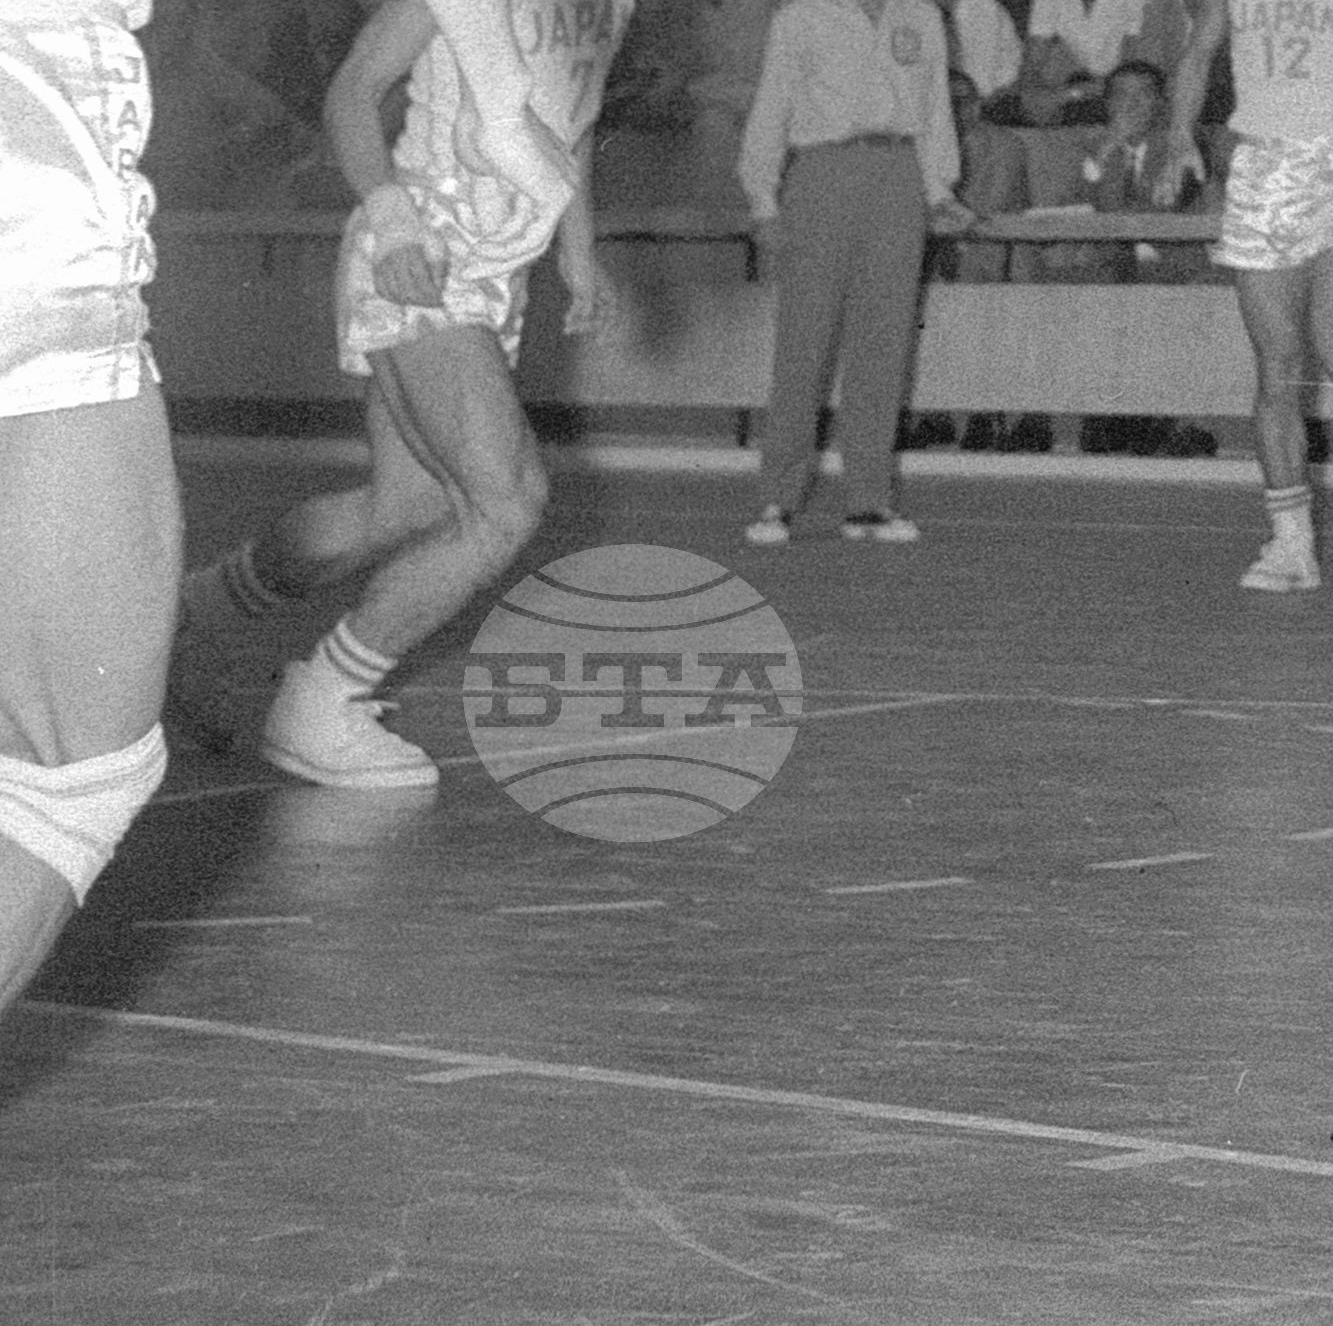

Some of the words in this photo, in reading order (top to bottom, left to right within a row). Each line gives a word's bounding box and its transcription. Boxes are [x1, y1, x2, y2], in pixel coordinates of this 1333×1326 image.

[529, 0, 616, 55] JAPA
[1262, 35, 1312, 79] 12
[570, 59, 595, 123] 7
